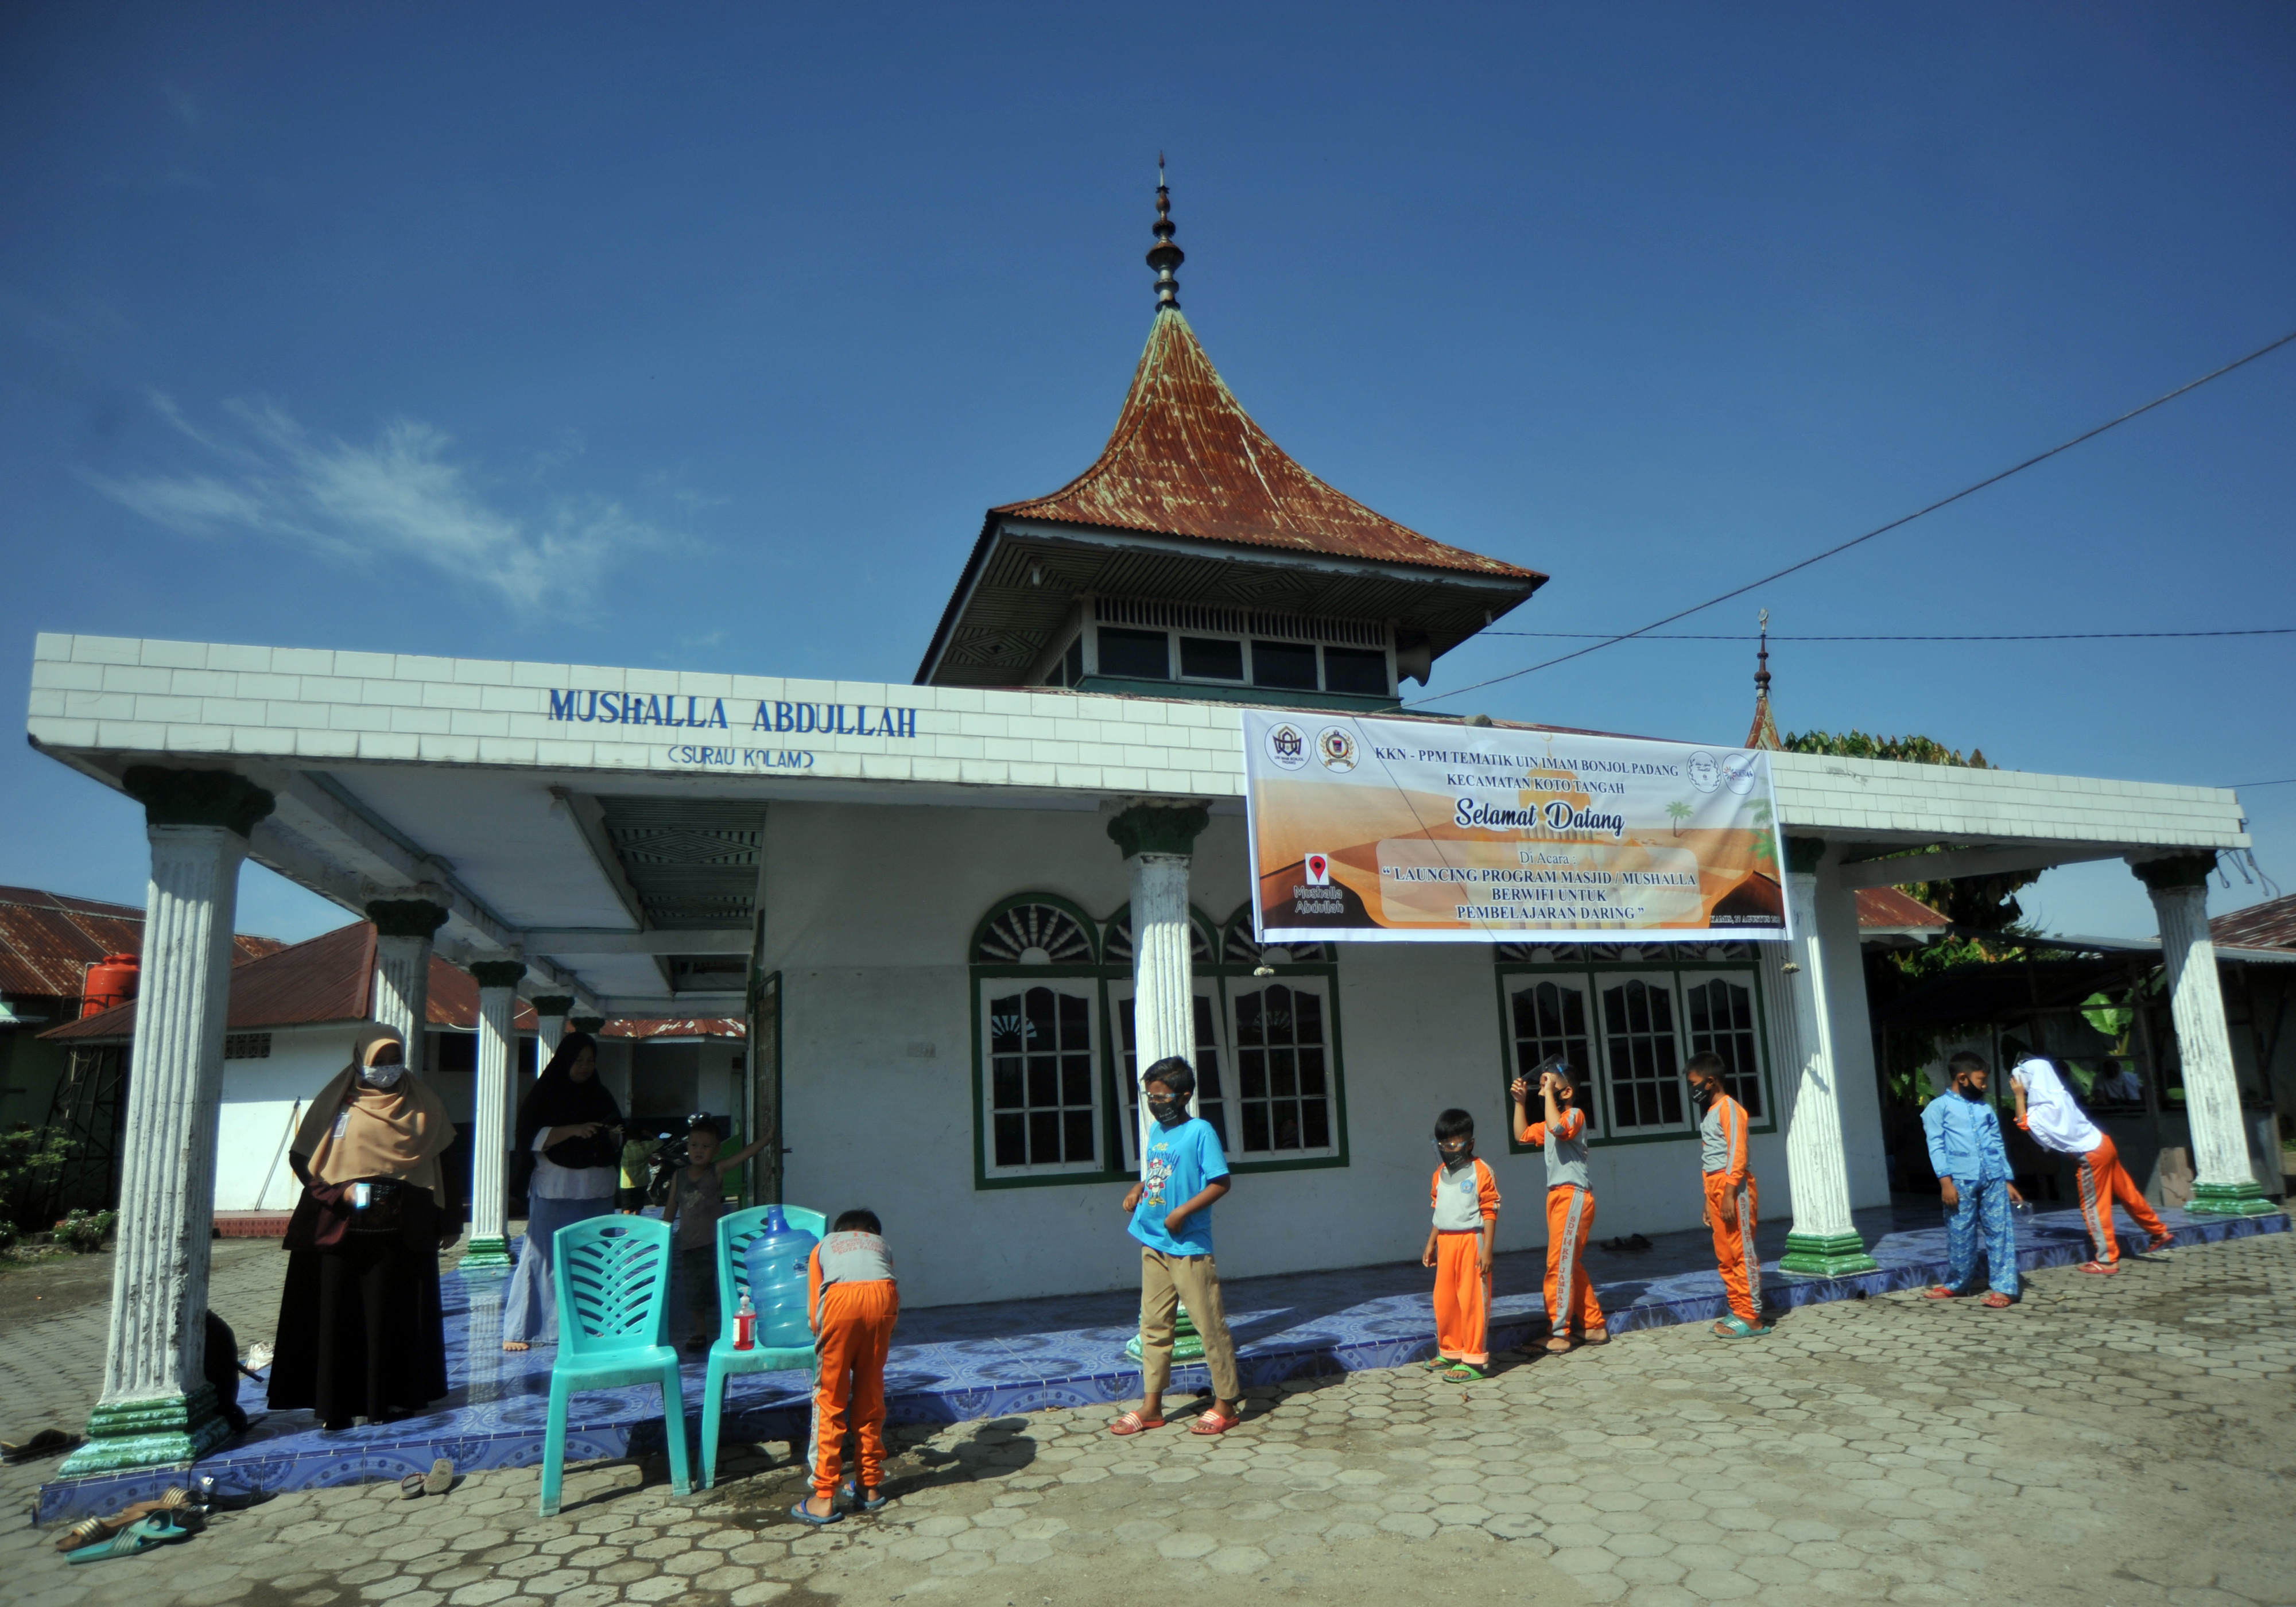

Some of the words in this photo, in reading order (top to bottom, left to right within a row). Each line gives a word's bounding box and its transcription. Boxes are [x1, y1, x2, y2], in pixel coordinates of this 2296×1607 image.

[549, 689, 728, 729] MUSHALLA
[752, 700, 916, 738] ABDULLAH
[668, 746, 735, 765] (SURAU
[1375, 747, 1407, 760] KKN
[1418, 750, 1447, 763] PPM
[1450, 751, 1514, 766] TEMATIK
[1515, 755, 1538, 768] UIN
[1541, 757, 1578, 771] IMAM
[1581, 759, 1630, 774] BONJOL
[1631, 763, 1679, 777] PADANG
[1446, 774, 1531, 789] KECAMATAN
[1534, 778, 1570, 792] KOTO
[1573, 780, 1626, 794] TANGAH
[1456, 798, 1537, 826] Selamat
[1545, 801, 1625, 837] Datang
[1520, 851, 1534, 864] Di
[1537, 852, 1570, 865] Acara
[1394, 868, 1478, 882] LAUNCING
[1482, 870, 1557, 883] PROGRAM
[1561, 871, 1612, 884] MASJID
[1622, 872, 1697, 886] MUSHALLA
[1294, 886, 1343, 899] Mushalla
[1492, 888, 1554, 901] BERWIFI
[1558, 890, 1607, 902] UNTUK
[1295, 900, 1344, 914] Abdullah
[1457, 906, 1576, 919] PEMBELAJARAN
[1580, 907, 1635, 919] DARING
[1566, 1216, 1576, 1236] SDN
[1563, 1237, 1573, 1247] 14
[1561, 1248, 1569, 1264] KP.
[1557, 1267, 1566, 1309] JAMBAK
